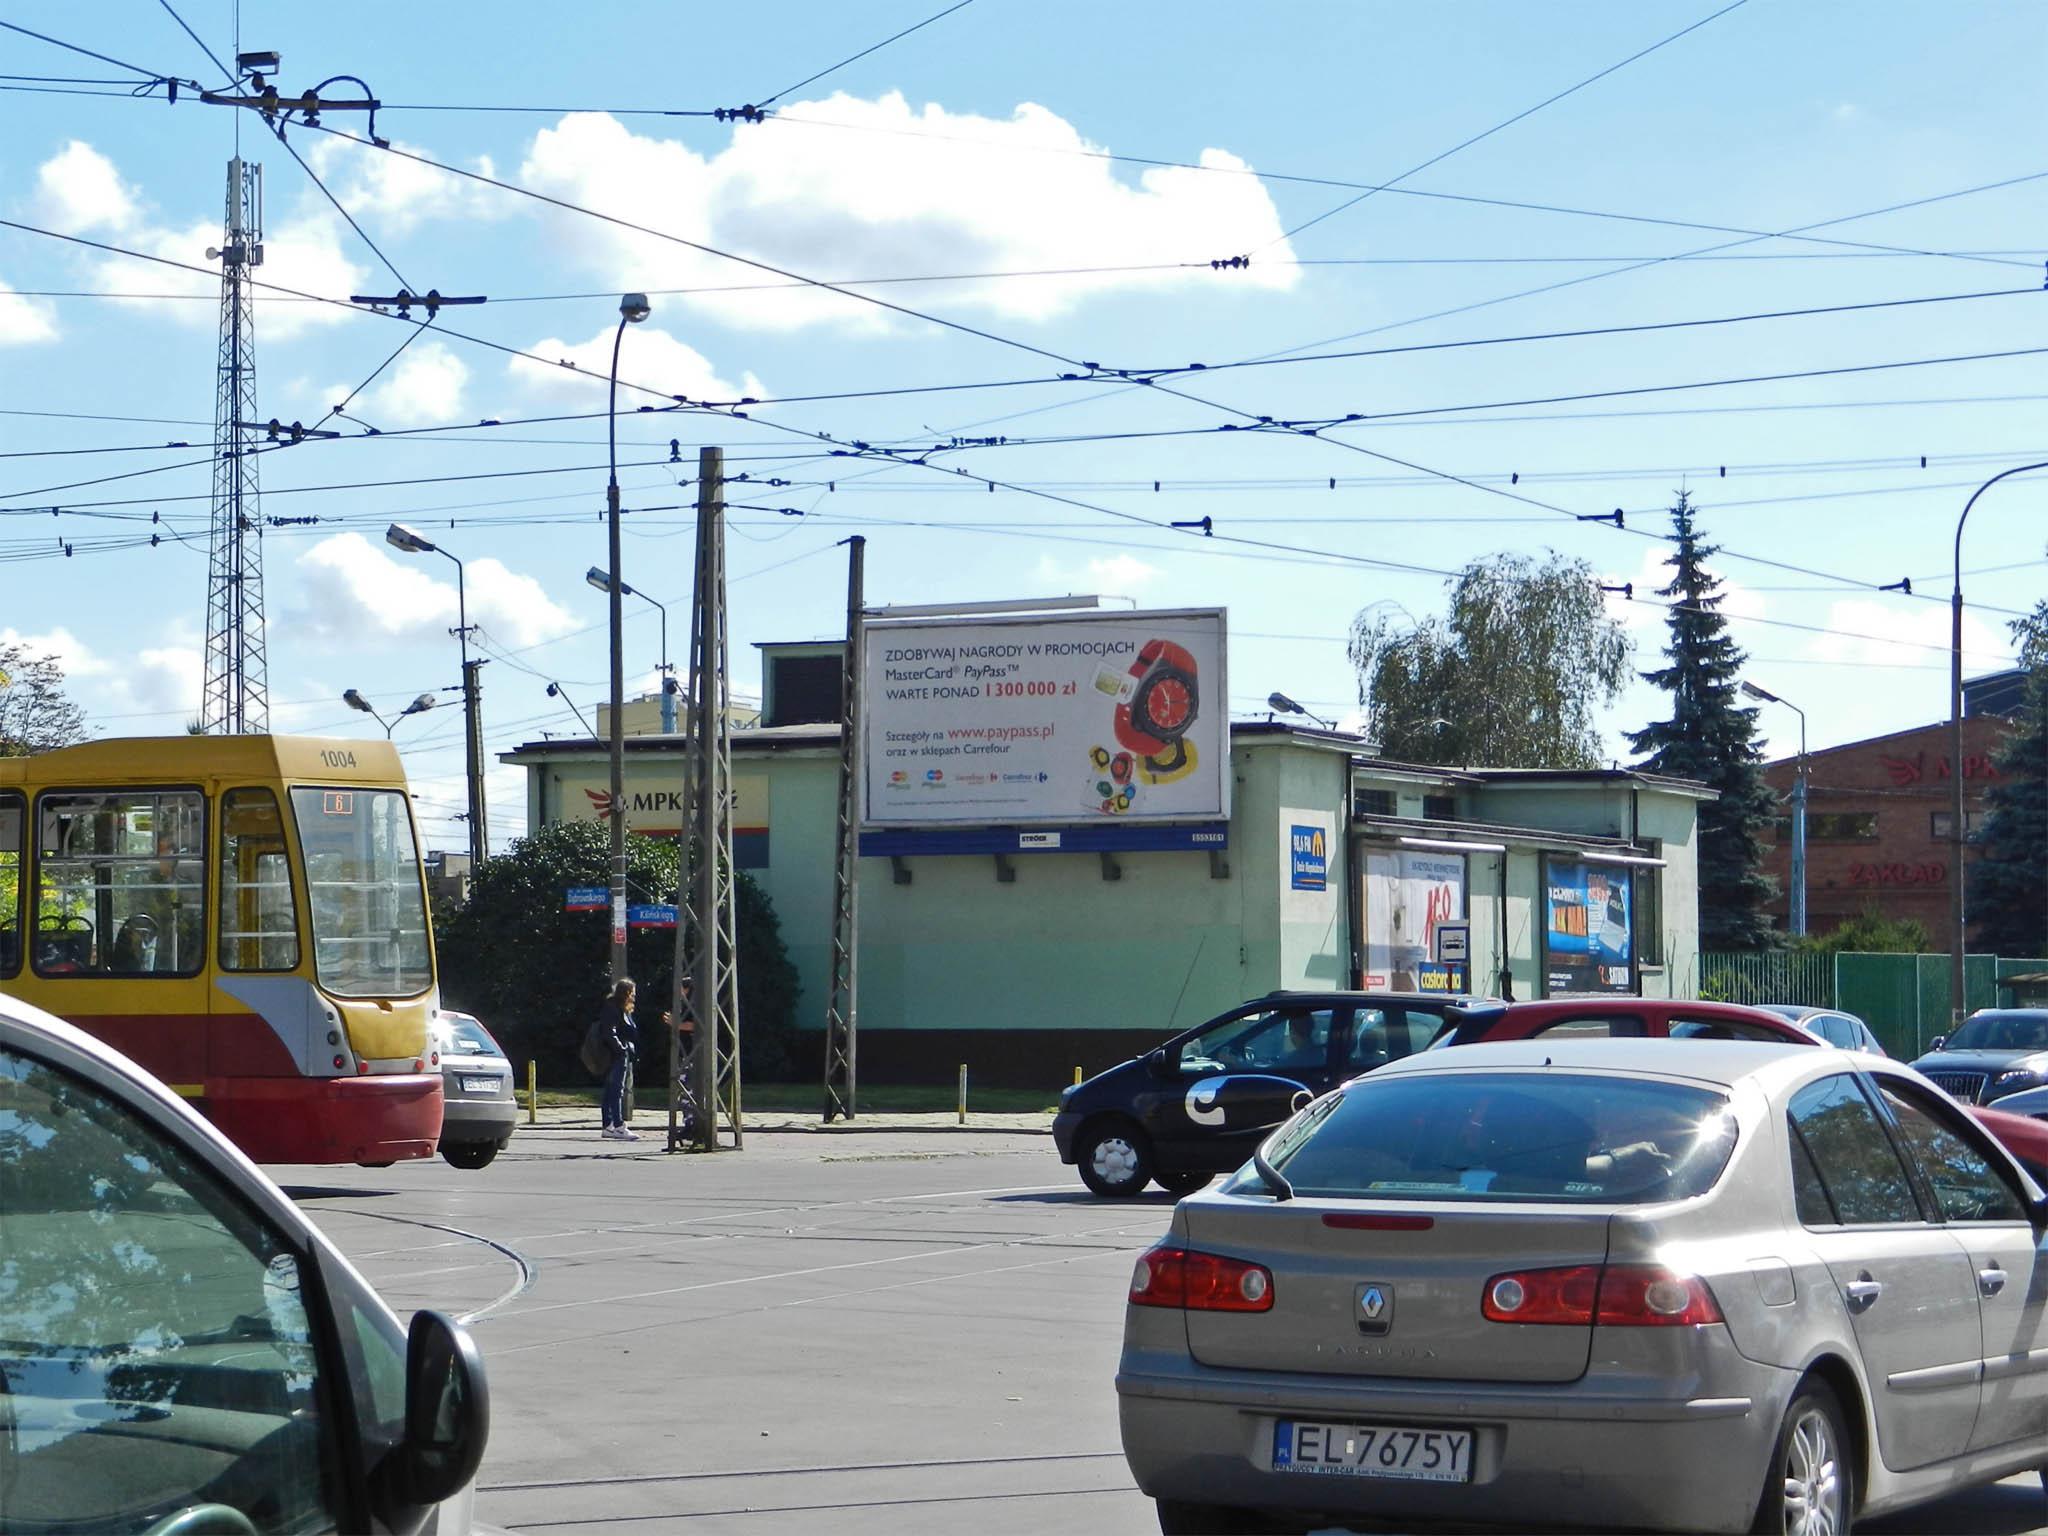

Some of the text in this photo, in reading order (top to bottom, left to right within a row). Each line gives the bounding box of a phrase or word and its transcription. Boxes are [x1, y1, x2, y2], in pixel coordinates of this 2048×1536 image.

[885, 641, 1135, 662] ZDOBYWAJ NAGRODY W PROMOCJACH
[886, 687, 929, 700] WARTE
[933, 686, 980, 698] PONAD
[1062, 680, 1077, 695] zł
[886, 723, 1055, 744] Szczegóły na www.paypass.pl
[321, 750, 357, 768] 1004
[886, 743, 1011, 758] oraz w sklepach Carrefour
[335, 794, 343, 812] 6
[633, 791, 683, 811] MPK
[1278, 1447, 1290, 1458] PL
[1296, 1427, 1465, 1471] EL 7675Y
